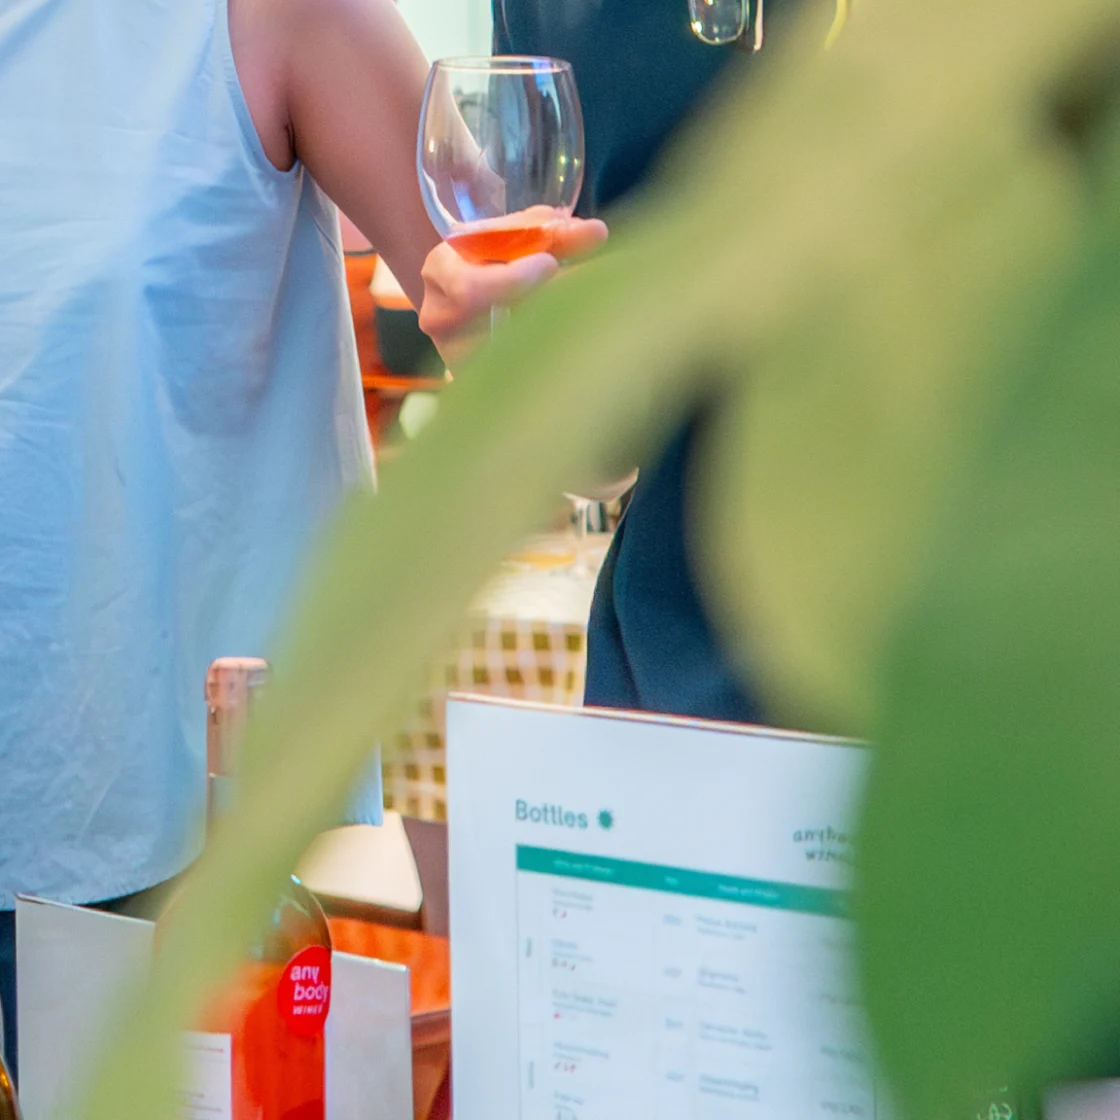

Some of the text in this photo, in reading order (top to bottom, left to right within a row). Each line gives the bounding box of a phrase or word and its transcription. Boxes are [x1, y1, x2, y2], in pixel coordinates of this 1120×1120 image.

[515, 798, 589, 829] Bottles
[290, 965, 320, 984] any
[293, 981, 328, 1003] body
